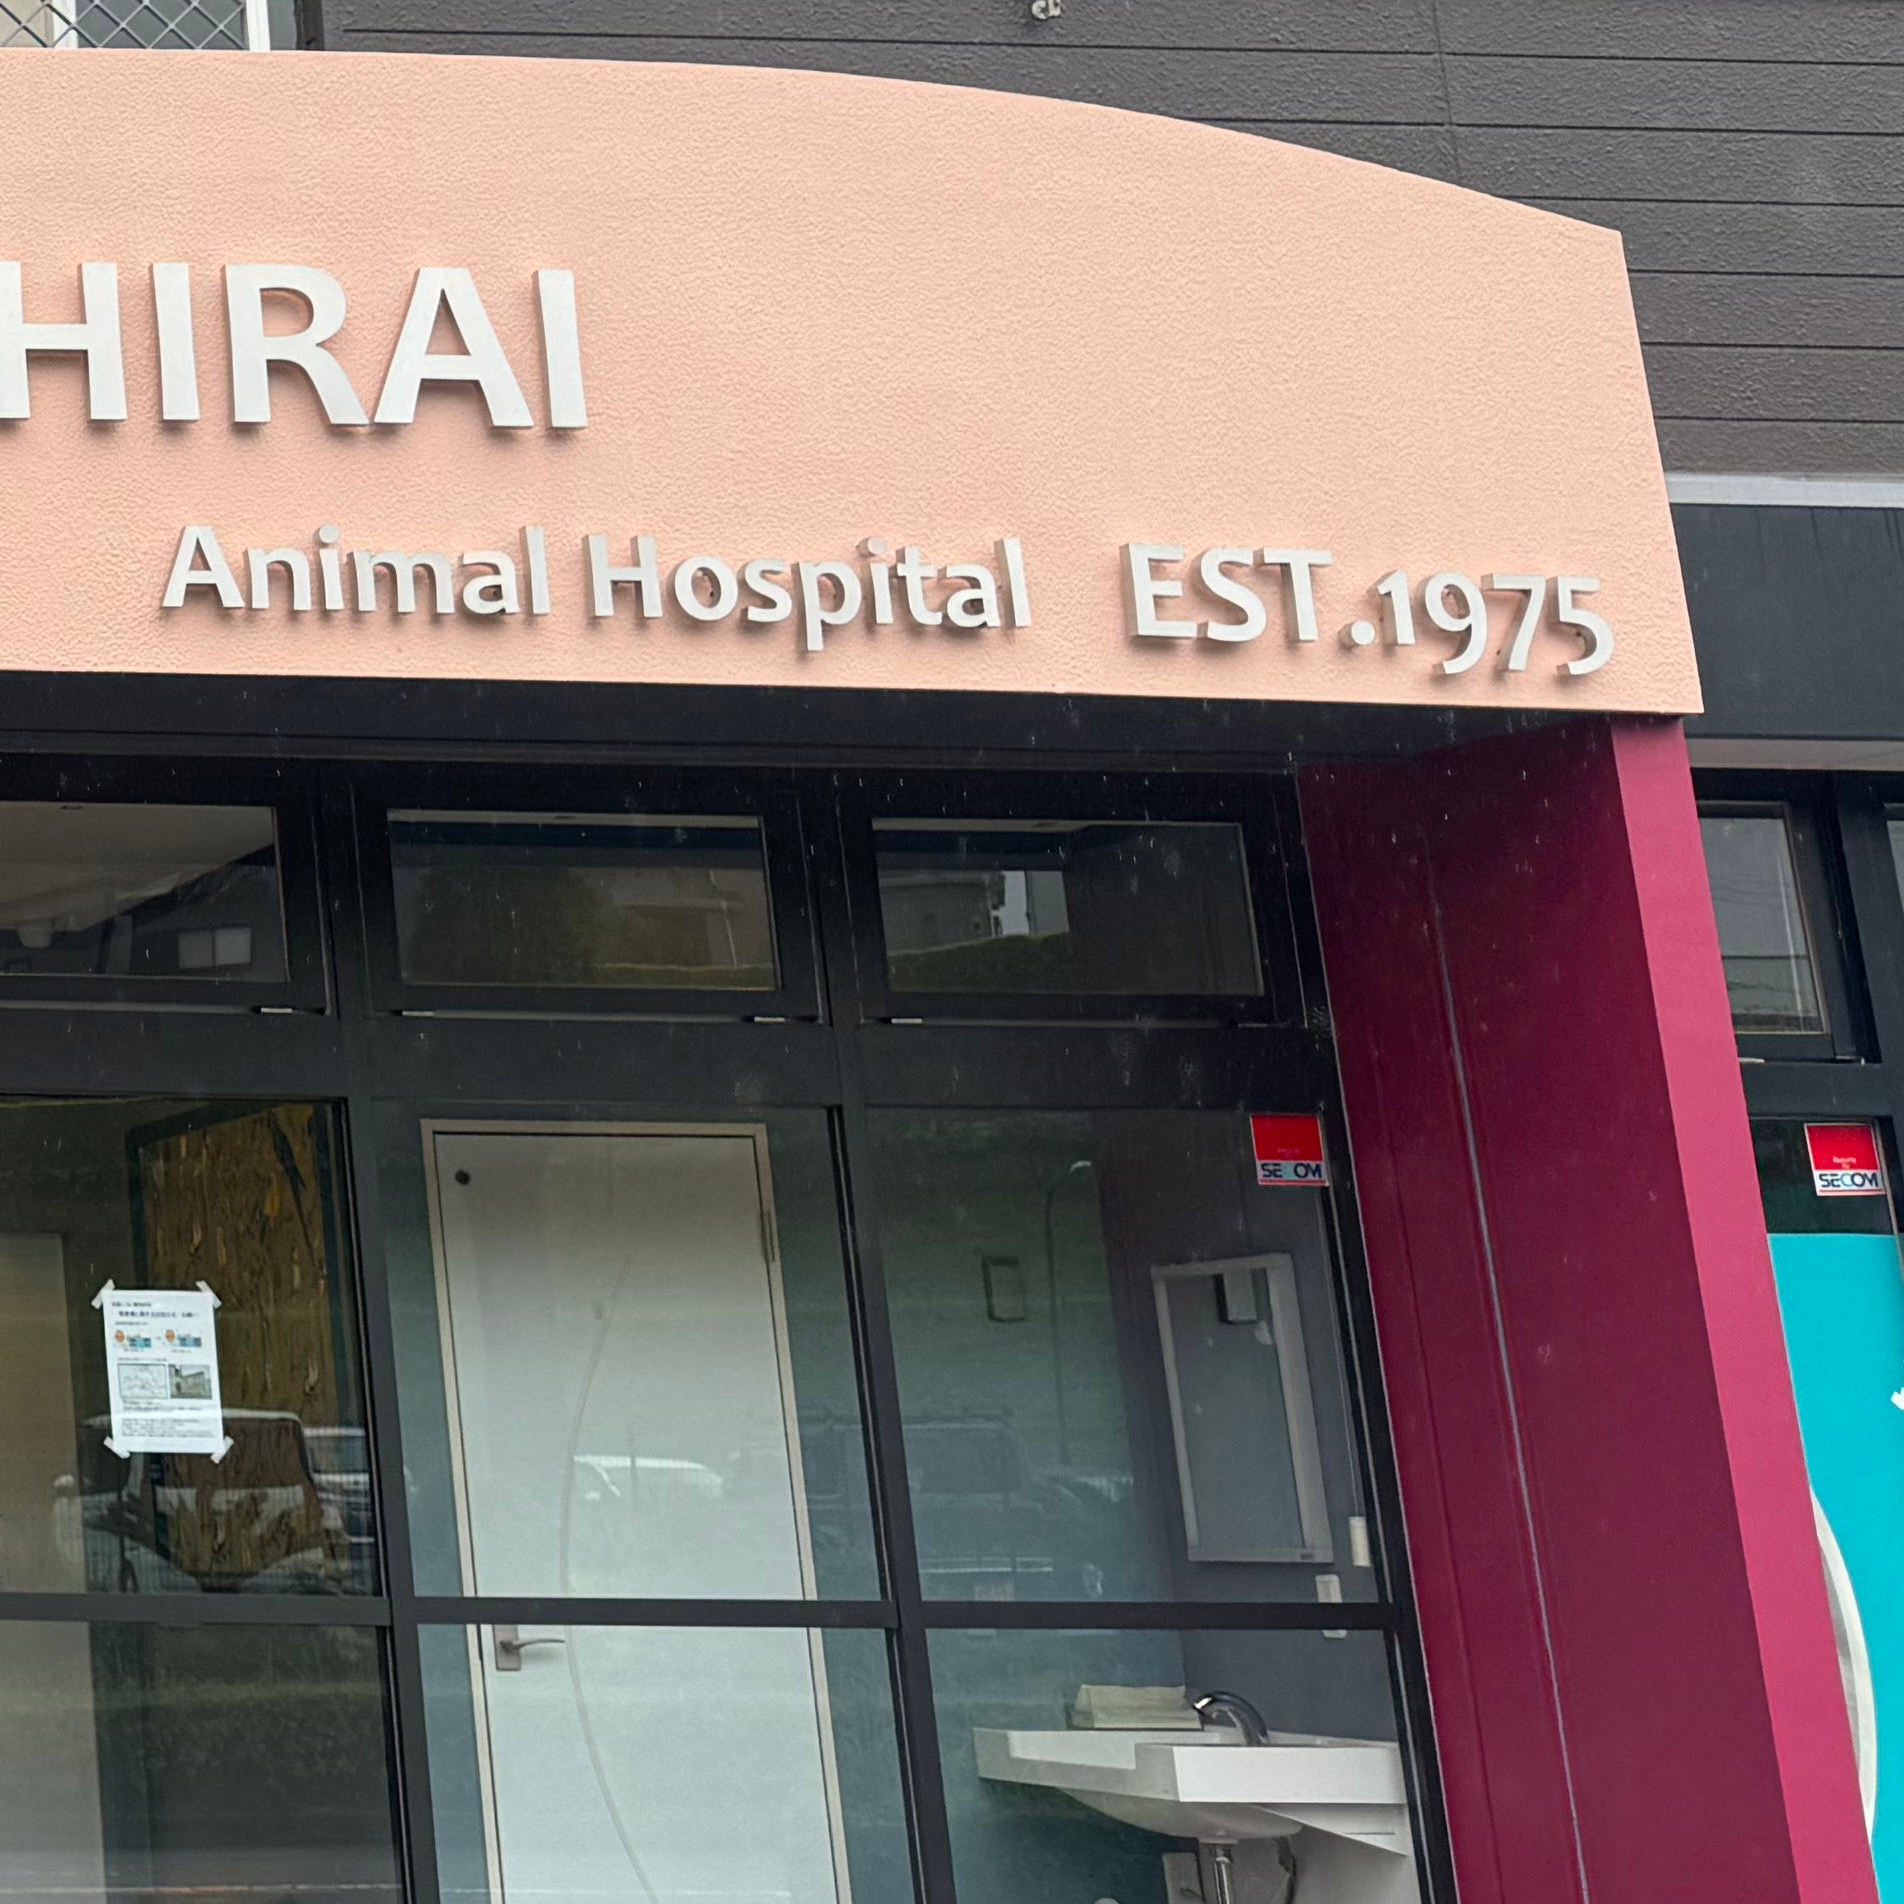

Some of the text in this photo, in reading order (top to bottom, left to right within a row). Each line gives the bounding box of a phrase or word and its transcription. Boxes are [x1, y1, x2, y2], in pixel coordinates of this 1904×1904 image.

[162, 523, 1615, 677] Animal Hospital EST.1975
[1818, 1172, 1879, 1188] SECOM
